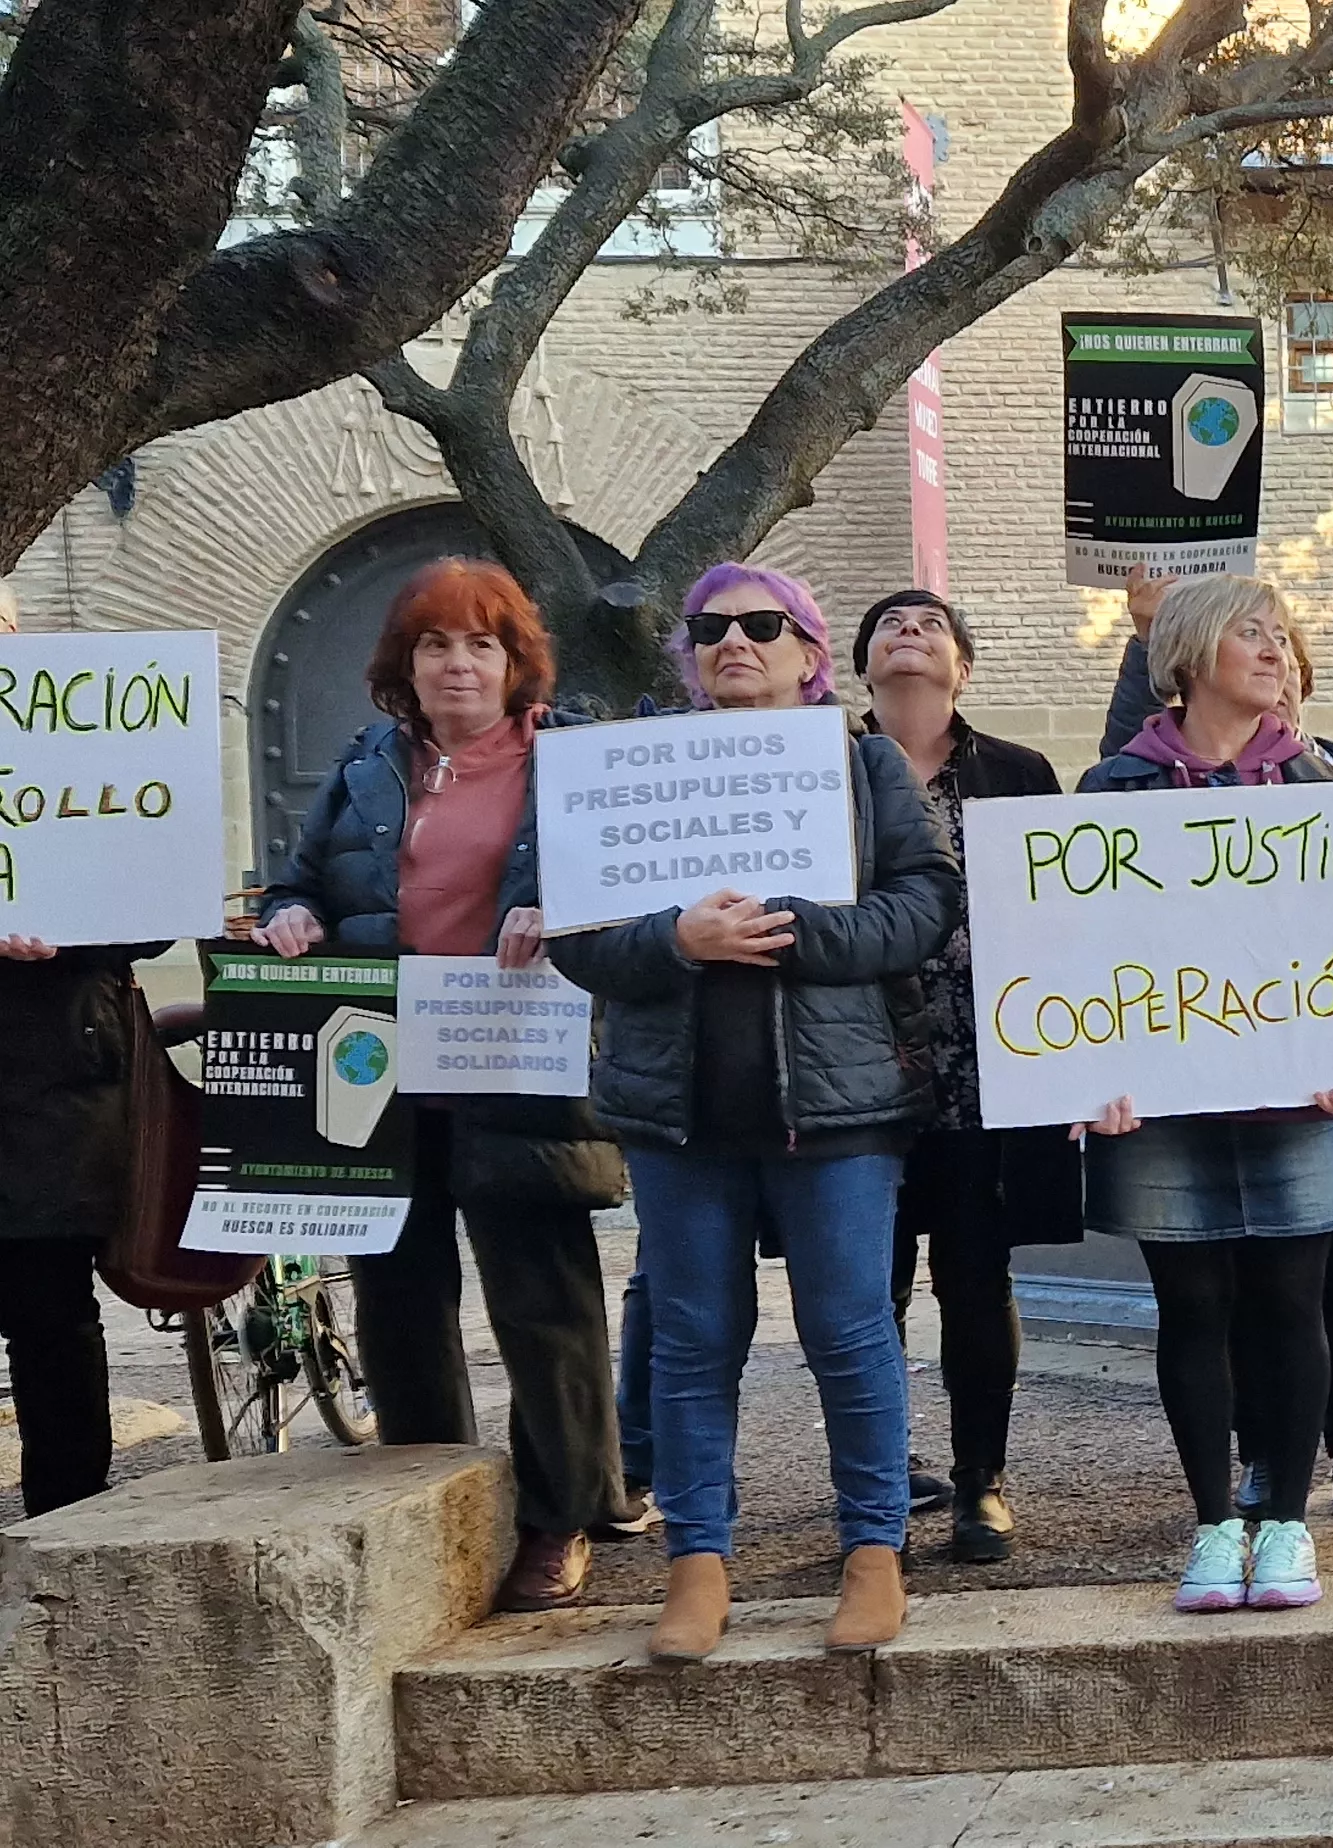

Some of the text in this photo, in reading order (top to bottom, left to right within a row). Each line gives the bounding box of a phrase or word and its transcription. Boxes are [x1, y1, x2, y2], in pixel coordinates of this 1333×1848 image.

[1079, 334, 1242, 353] ¡NOS QUIEREN ENTERRAR!
[1068, 397, 1168, 416] ENTIERRO
[1068, 416, 1125, 429] POR LA
[1068, 428, 1150, 443] COOPERACIÓN
[1068, 444, 1161, 459] INTERNACIONAL
[1075, 544, 1249, 561] NO AL RECORTE EN COOPERACIÓN
[1150, 567, 1163, 579] ES
[605, 733, 786, 770] POR UNOS
[564, 769, 842, 814] PRESUPUESTOS
[600, 808, 808, 848] SOCIALES Y
[600, 848, 813, 888] SOLIDARIOS
[1024, 821, 1165, 901] POR
[222, 963, 394, 985] ¡NOS QUIEREN ENTERRAR!
[442, 972, 560, 989] POR UNOS
[414, 1000, 588, 1018] PRESUPUESTOS
[207, 1030, 315, 1051] ENTIERRO
[437, 1027, 568, 1045] SOCIALES Y
[206, 1050, 269, 1065] POR LA
[436, 1054, 569, 1073] SOLIDARIOS
[205, 1064, 295, 1081] COOPERACIÓN
[204, 1080, 306, 1097] INTERNACIONAL
[201, 1200, 397, 1218] NO AL RECORTE EN COOPERACIÓN
[221, 1219, 369, 1238] HUESCA ES SOLIDARIA
